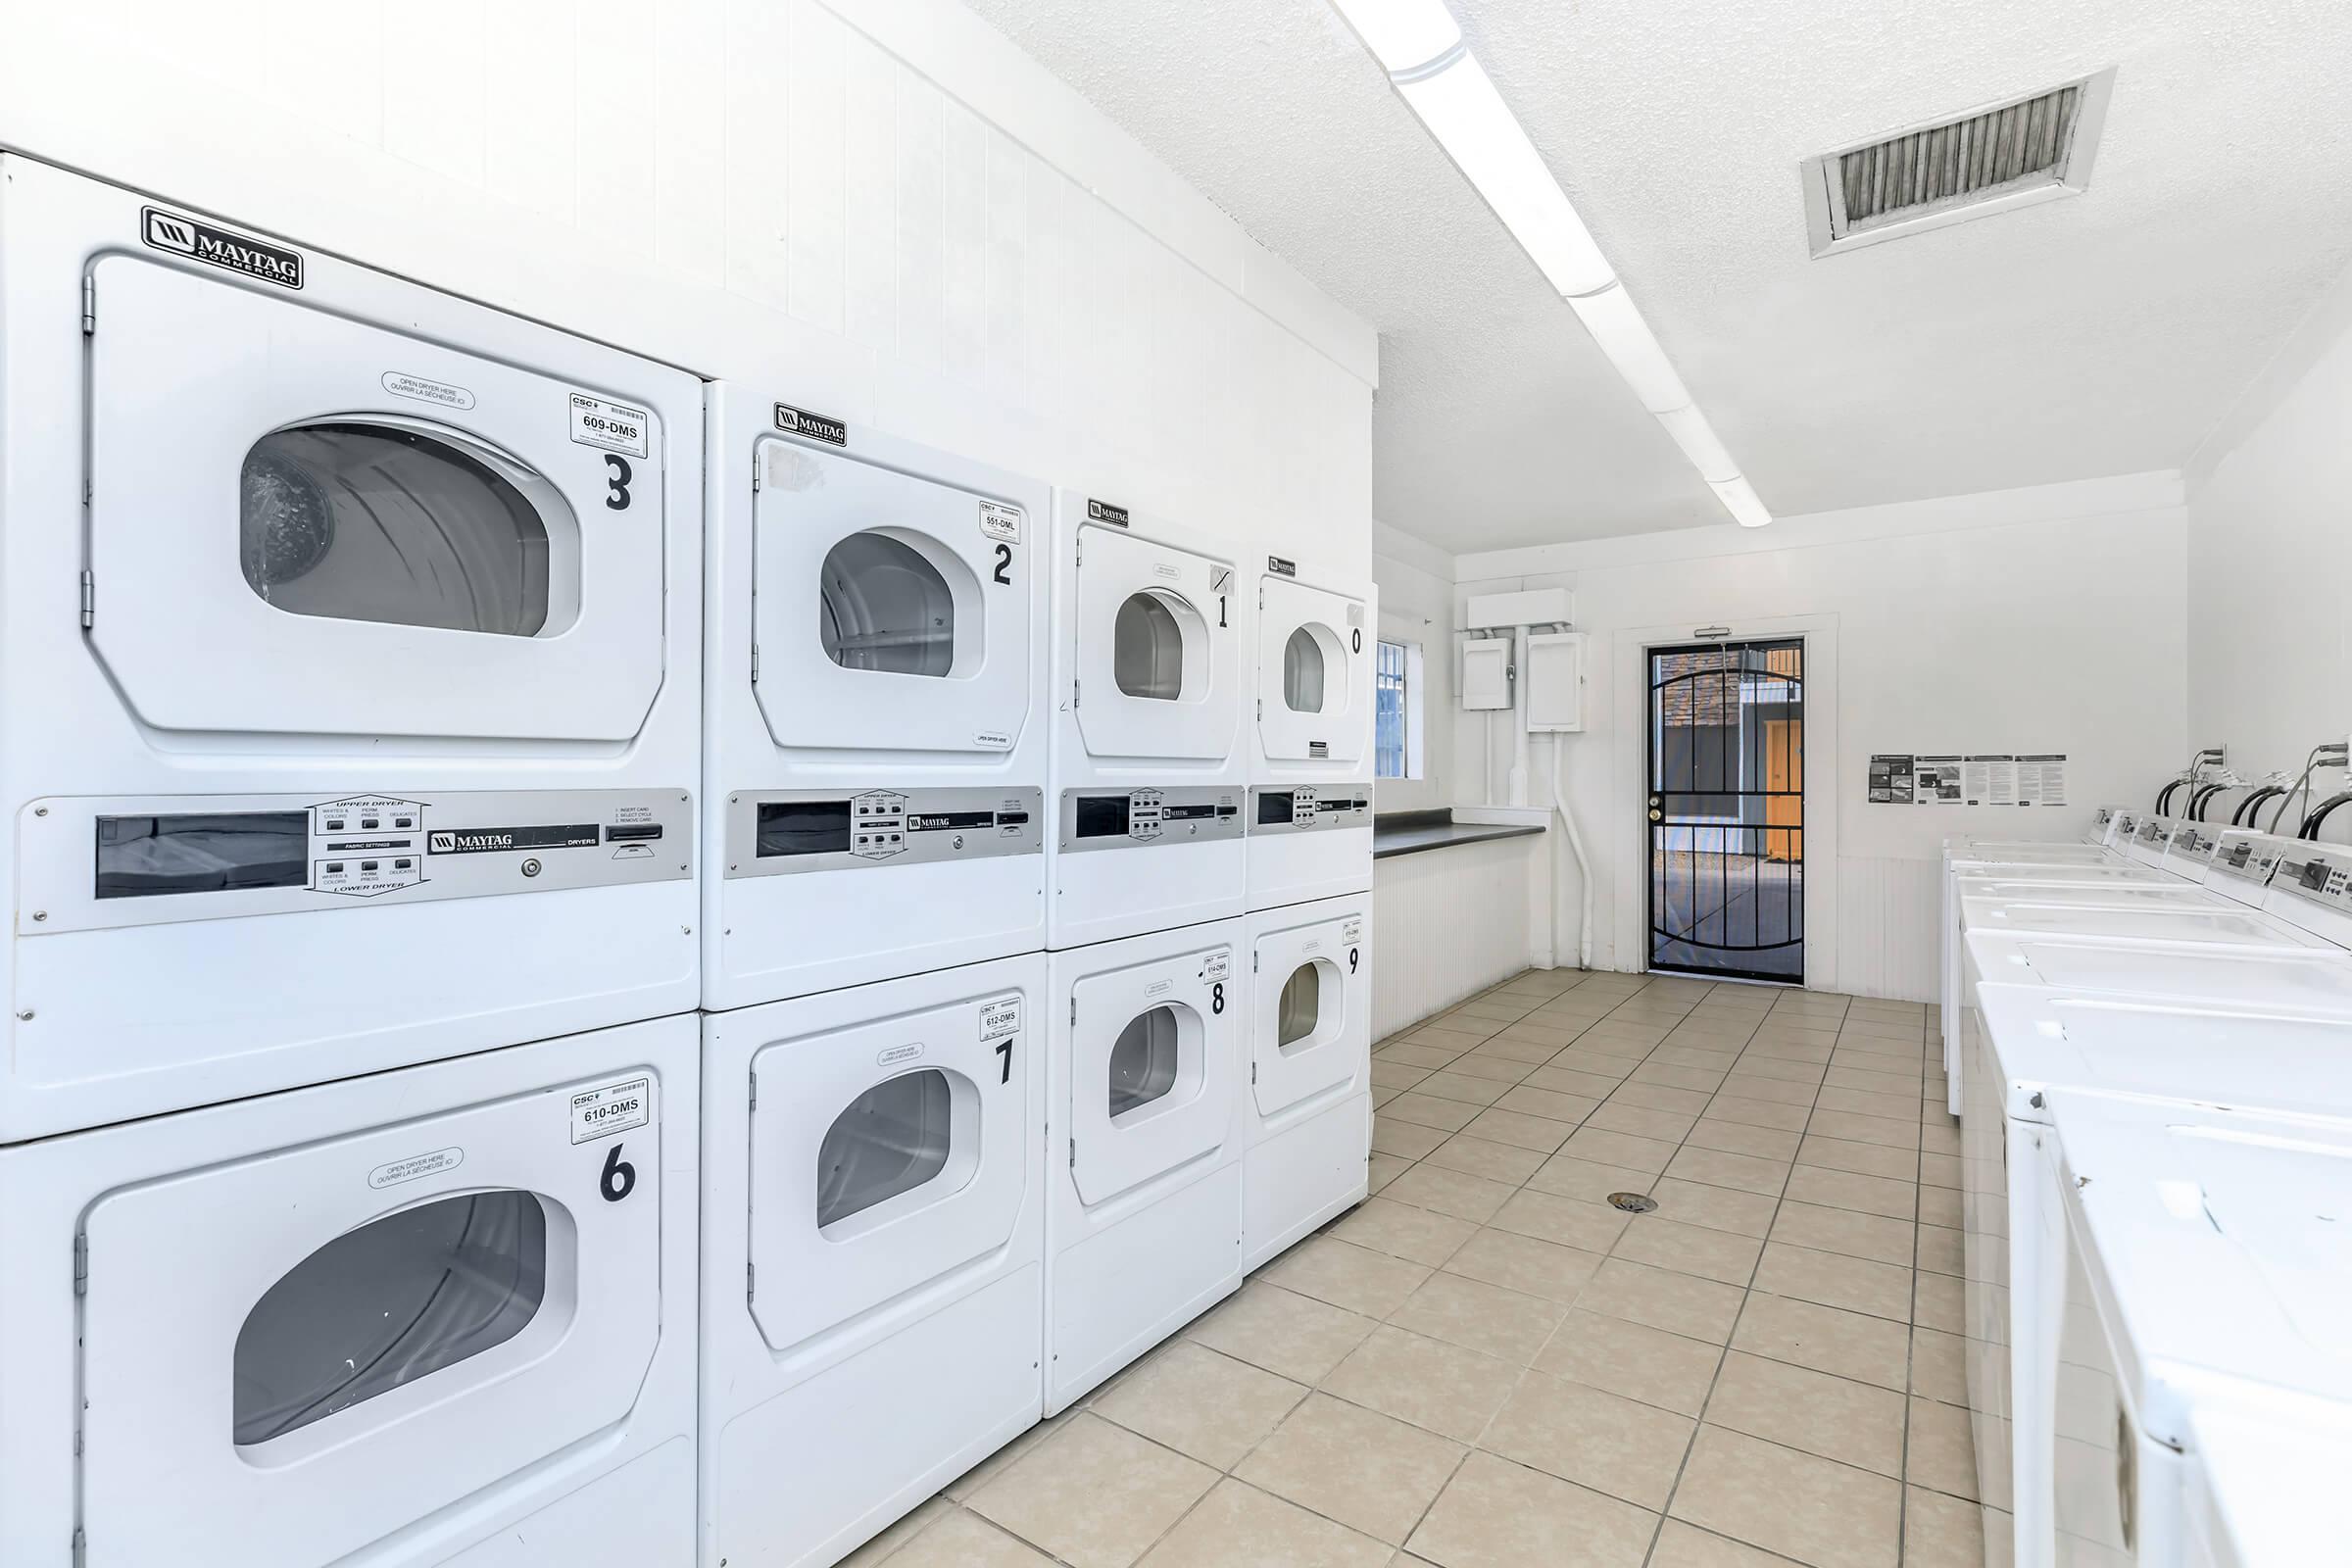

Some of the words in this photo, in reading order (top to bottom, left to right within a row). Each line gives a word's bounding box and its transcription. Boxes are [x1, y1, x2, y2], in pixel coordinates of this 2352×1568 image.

[198, 234, 297, 278] MAYTAG
[198, 250, 296, 284] COMMERCIAL
[400, 377, 417, 388] OPEN
[418, 382, 440, 393] DRYER
[572, 397, 593, 408] CSC
[583, 415, 638, 439] 609-DMS
[799, 416, 844, 439] MAYTAG
[604, 453, 632, 511] 3
[986, 515, 1015, 531] 551-DML
[1102, 507, 1128, 523] MAYTAG
[993, 543, 1012, 586] 2
[1219, 595, 1228, 628] 1
[1351, 627, 1361, 655] 0
[920, 817, 950, 828] MAYTAG
[457, 834, 513, 848] MAYTAG
[567, 837, 597, 846] DRYERS
[333, 883, 370, 893] LOWER
[1348, 947, 1359, 975] 9
[1212, 982, 1225, 1015] 8
[986, 1011, 1016, 1026] 612-DMS
[995, 1037, 1013, 1086] 7
[573, 1094, 594, 1105] CSC
[584, 1099, 639, 1122] 610-DMS
[599, 1142, 636, 1202] 6
